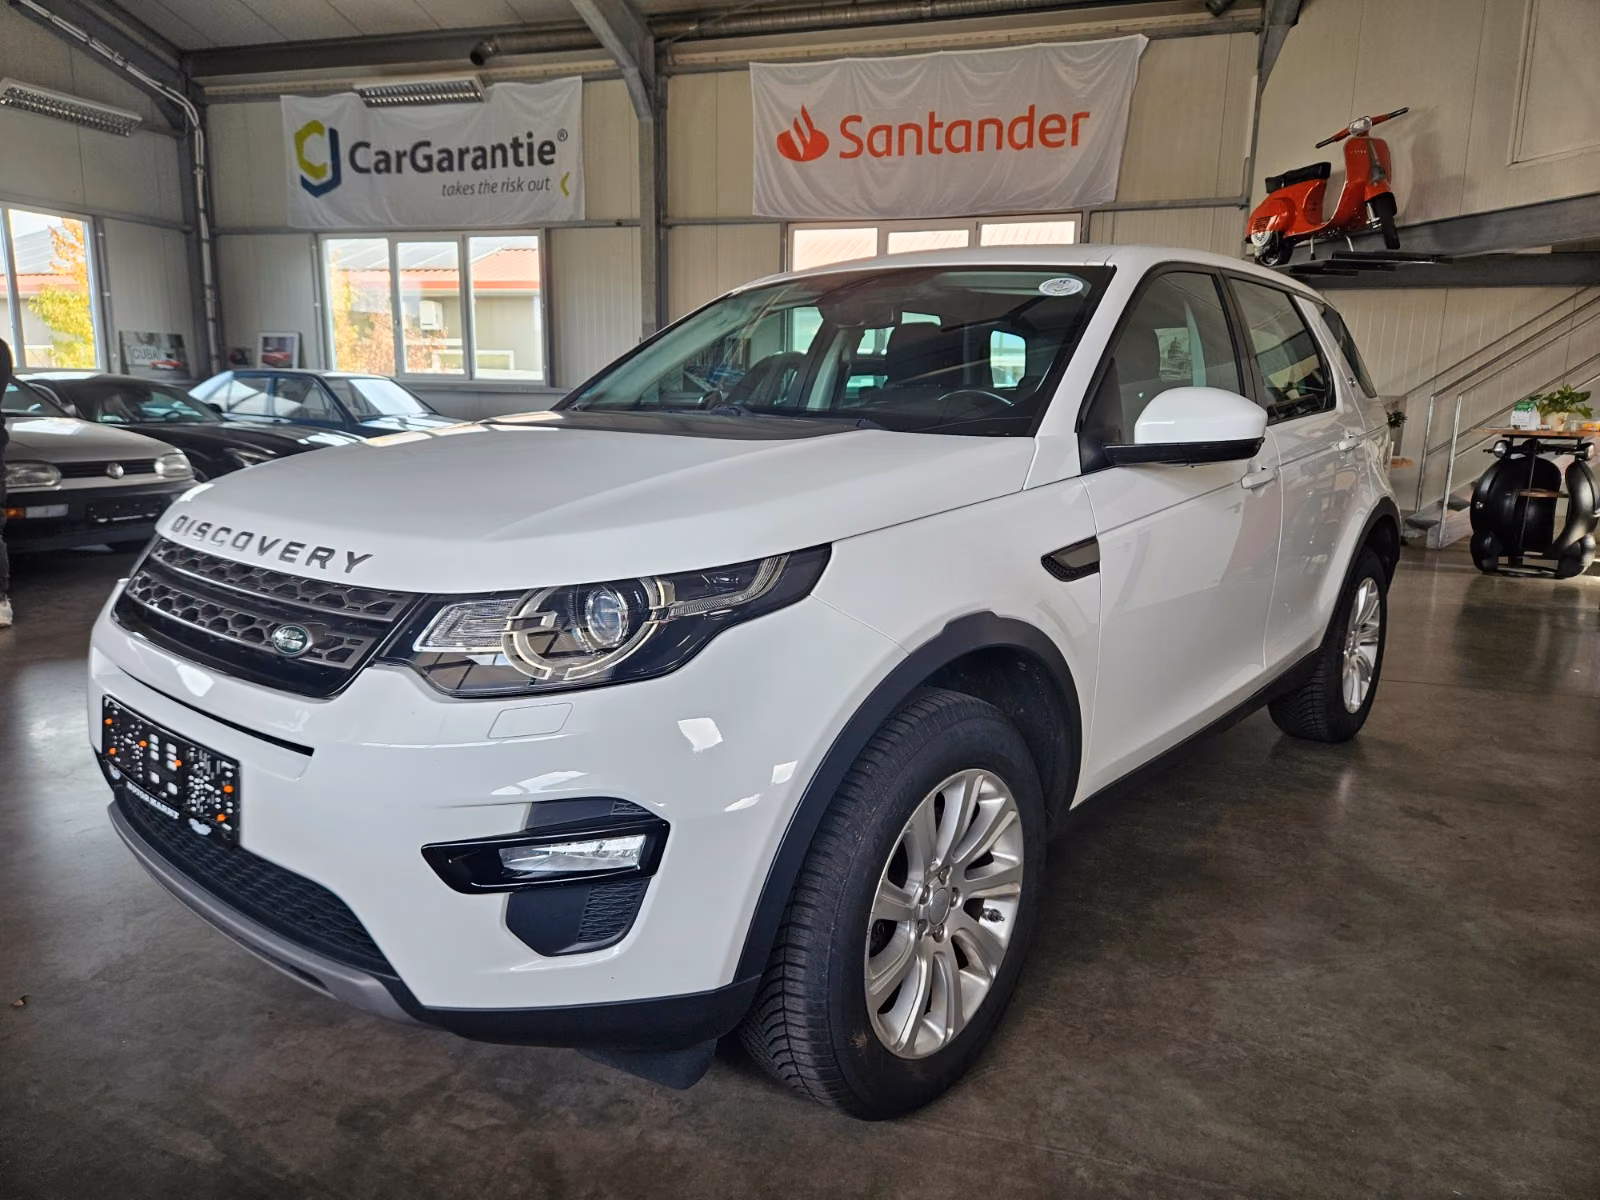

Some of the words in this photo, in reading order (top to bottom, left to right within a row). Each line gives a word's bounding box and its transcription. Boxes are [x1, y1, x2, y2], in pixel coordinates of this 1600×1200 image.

[839, 105, 1090, 159] Santander
[442, 181, 475, 197] takes
[478, 179, 498, 194] the
[501, 177, 524, 193] risk
[527, 177, 551, 191] out
[170, 514, 374, 574] DISCOVERY
